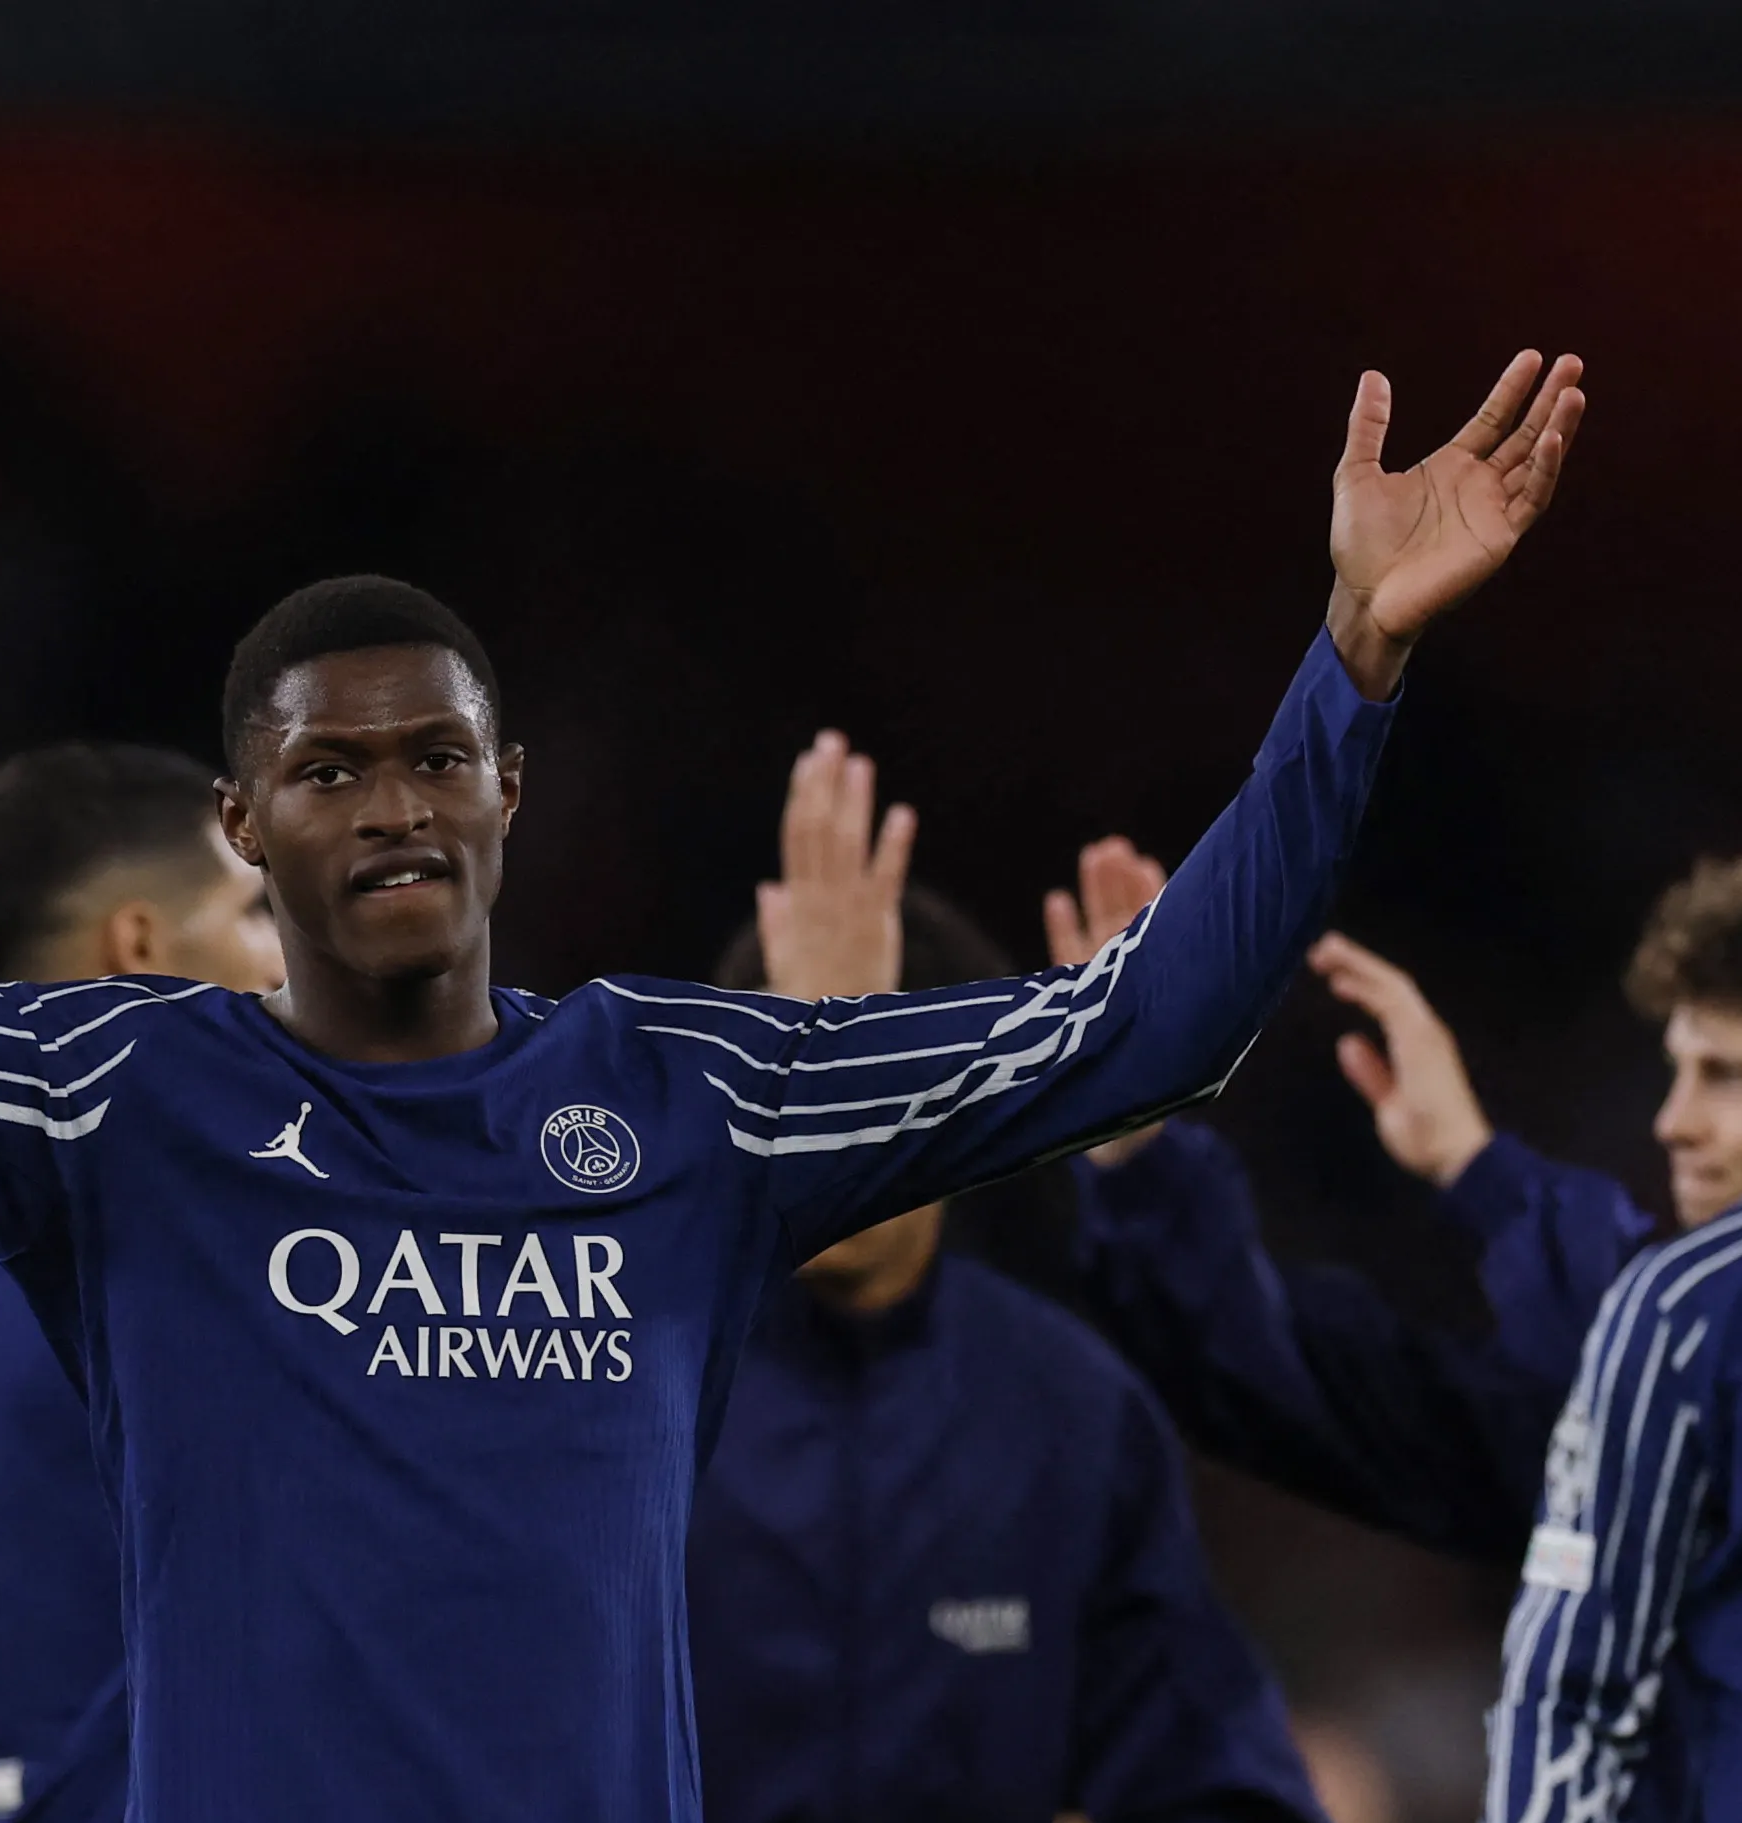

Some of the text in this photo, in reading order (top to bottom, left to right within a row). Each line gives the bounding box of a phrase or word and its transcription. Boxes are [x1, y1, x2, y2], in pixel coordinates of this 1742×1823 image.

[548, 1109, 606, 1138] PARIS
[268, 1228, 633, 1335] QATAR
[366, 1325, 633, 1382] AIRWAYS
